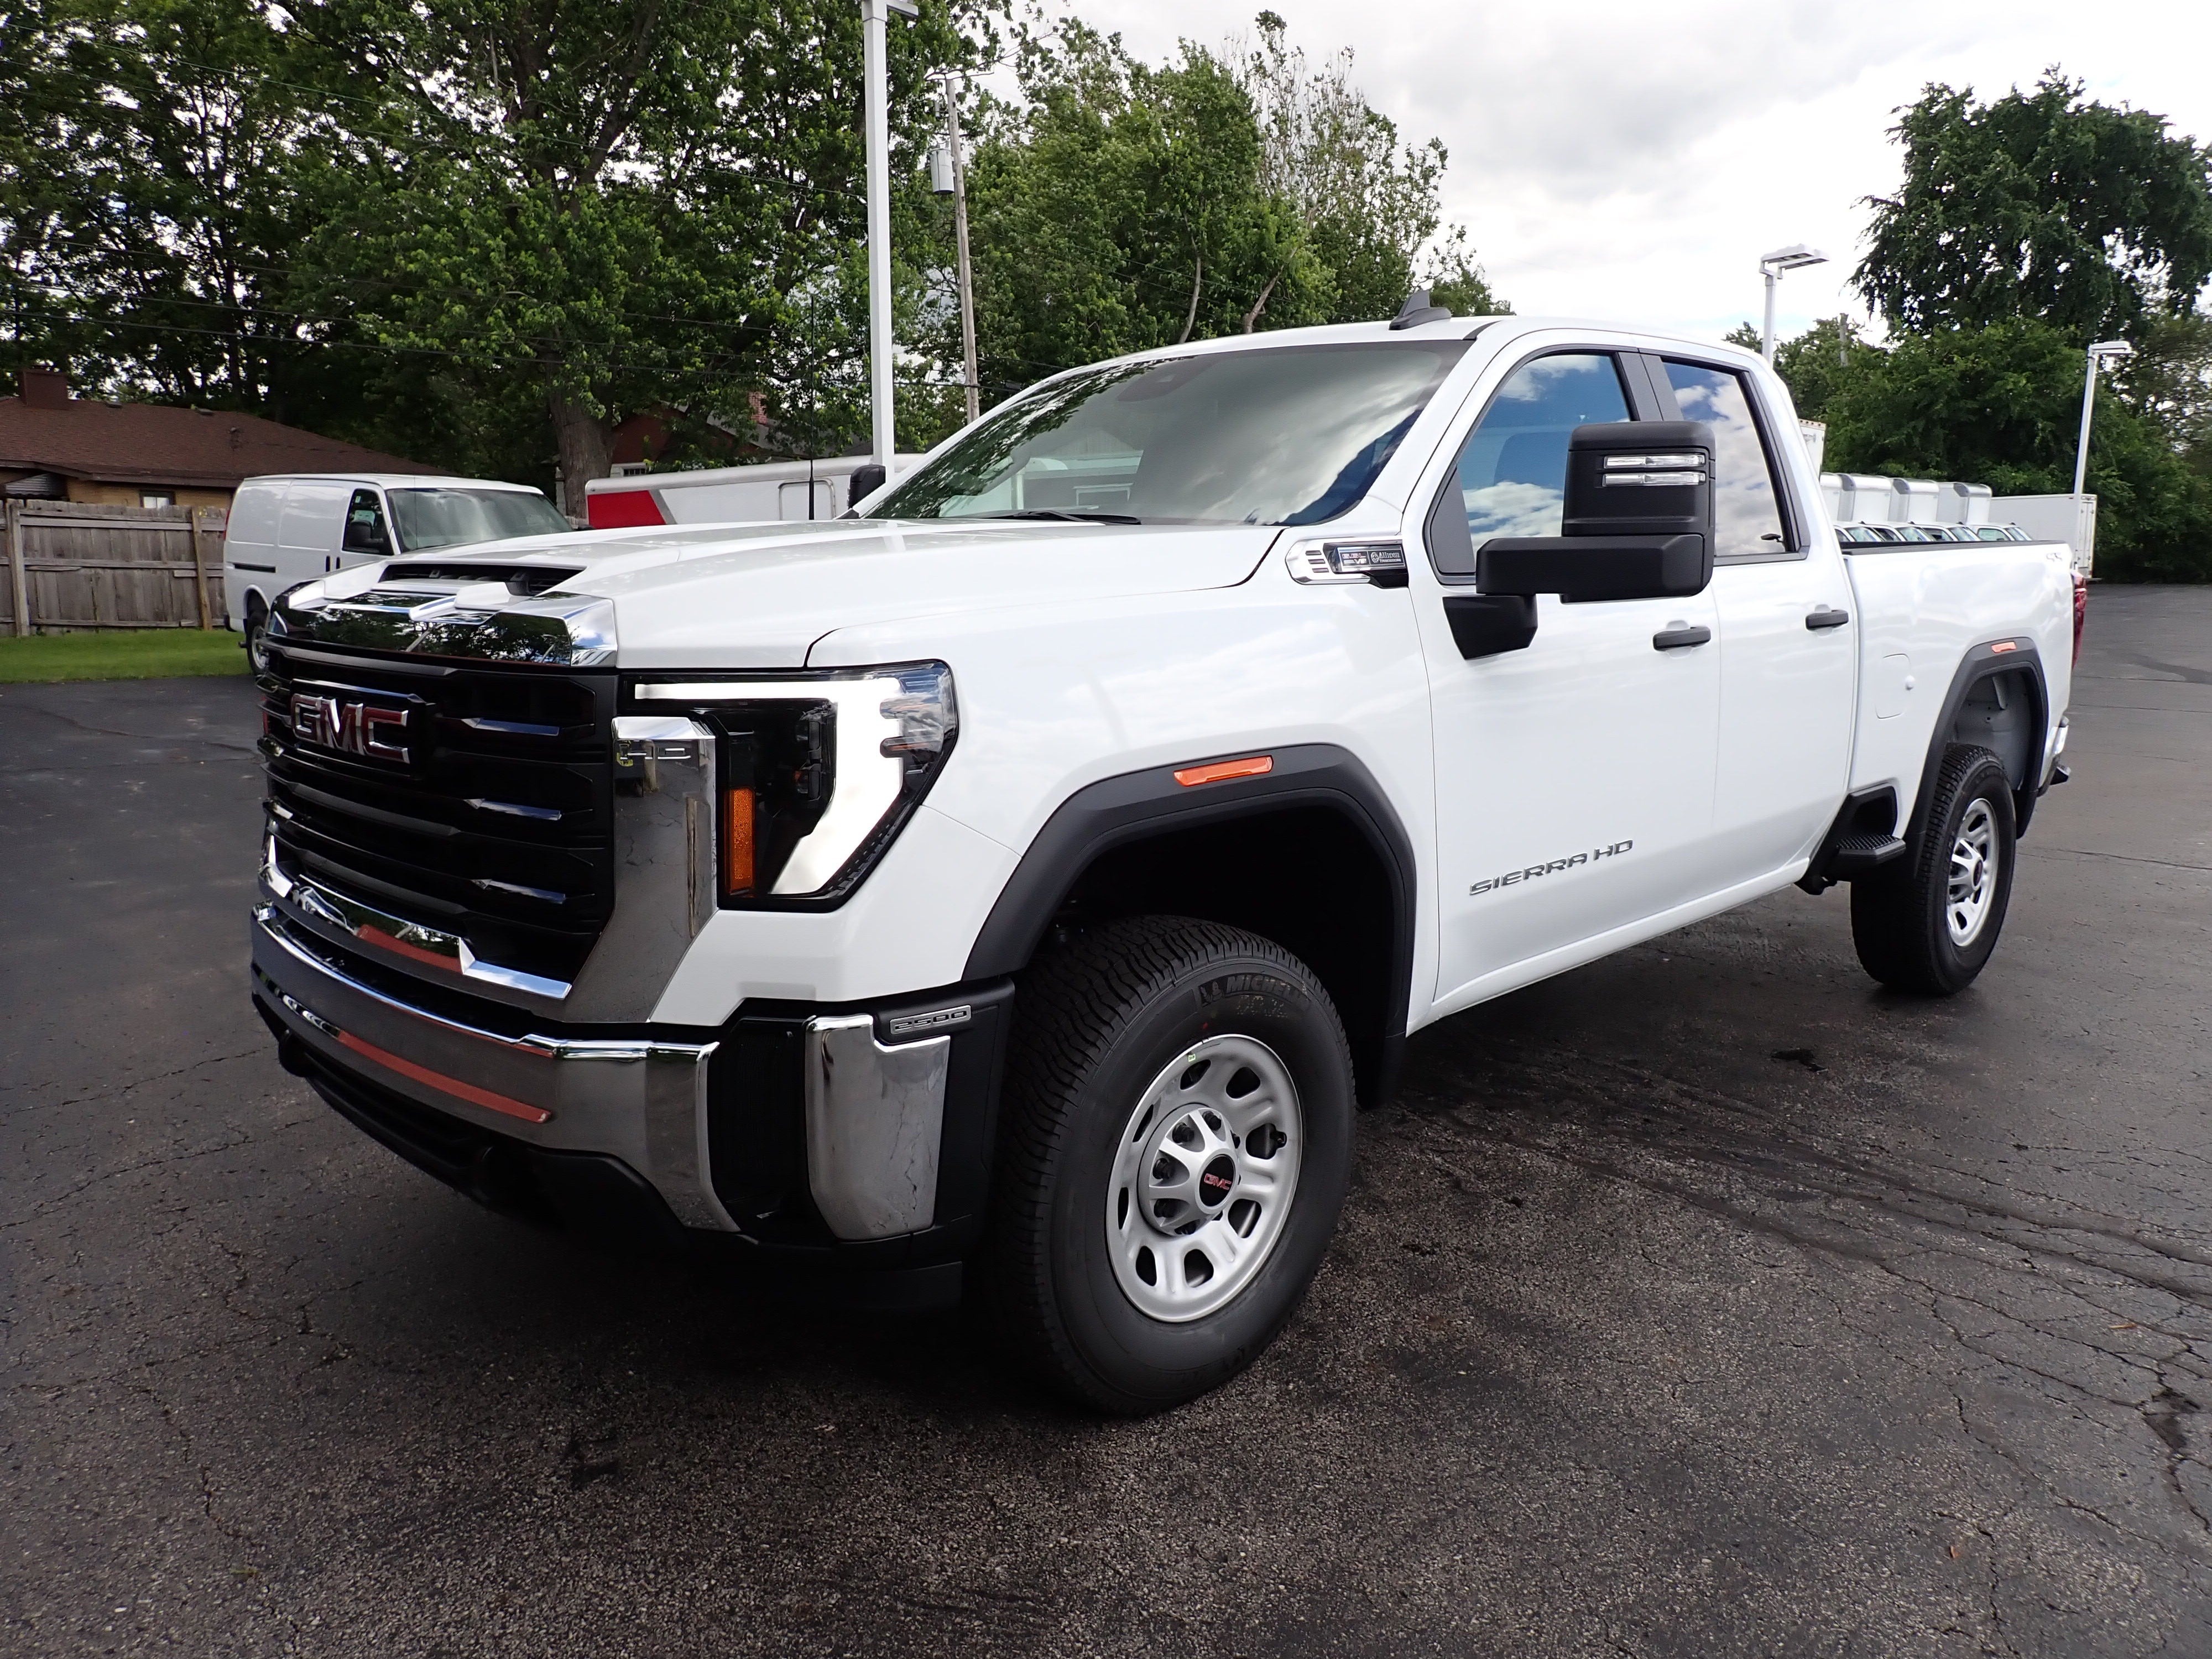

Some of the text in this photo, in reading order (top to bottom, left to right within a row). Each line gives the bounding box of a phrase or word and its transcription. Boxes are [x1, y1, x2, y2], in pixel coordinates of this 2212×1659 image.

[290, 693, 410, 764] GMC
[1469, 839, 1633, 895] SIERRA HD
[894, 1010, 967, 1031] 2500
[1203, 1173, 1232, 1190] GMC
